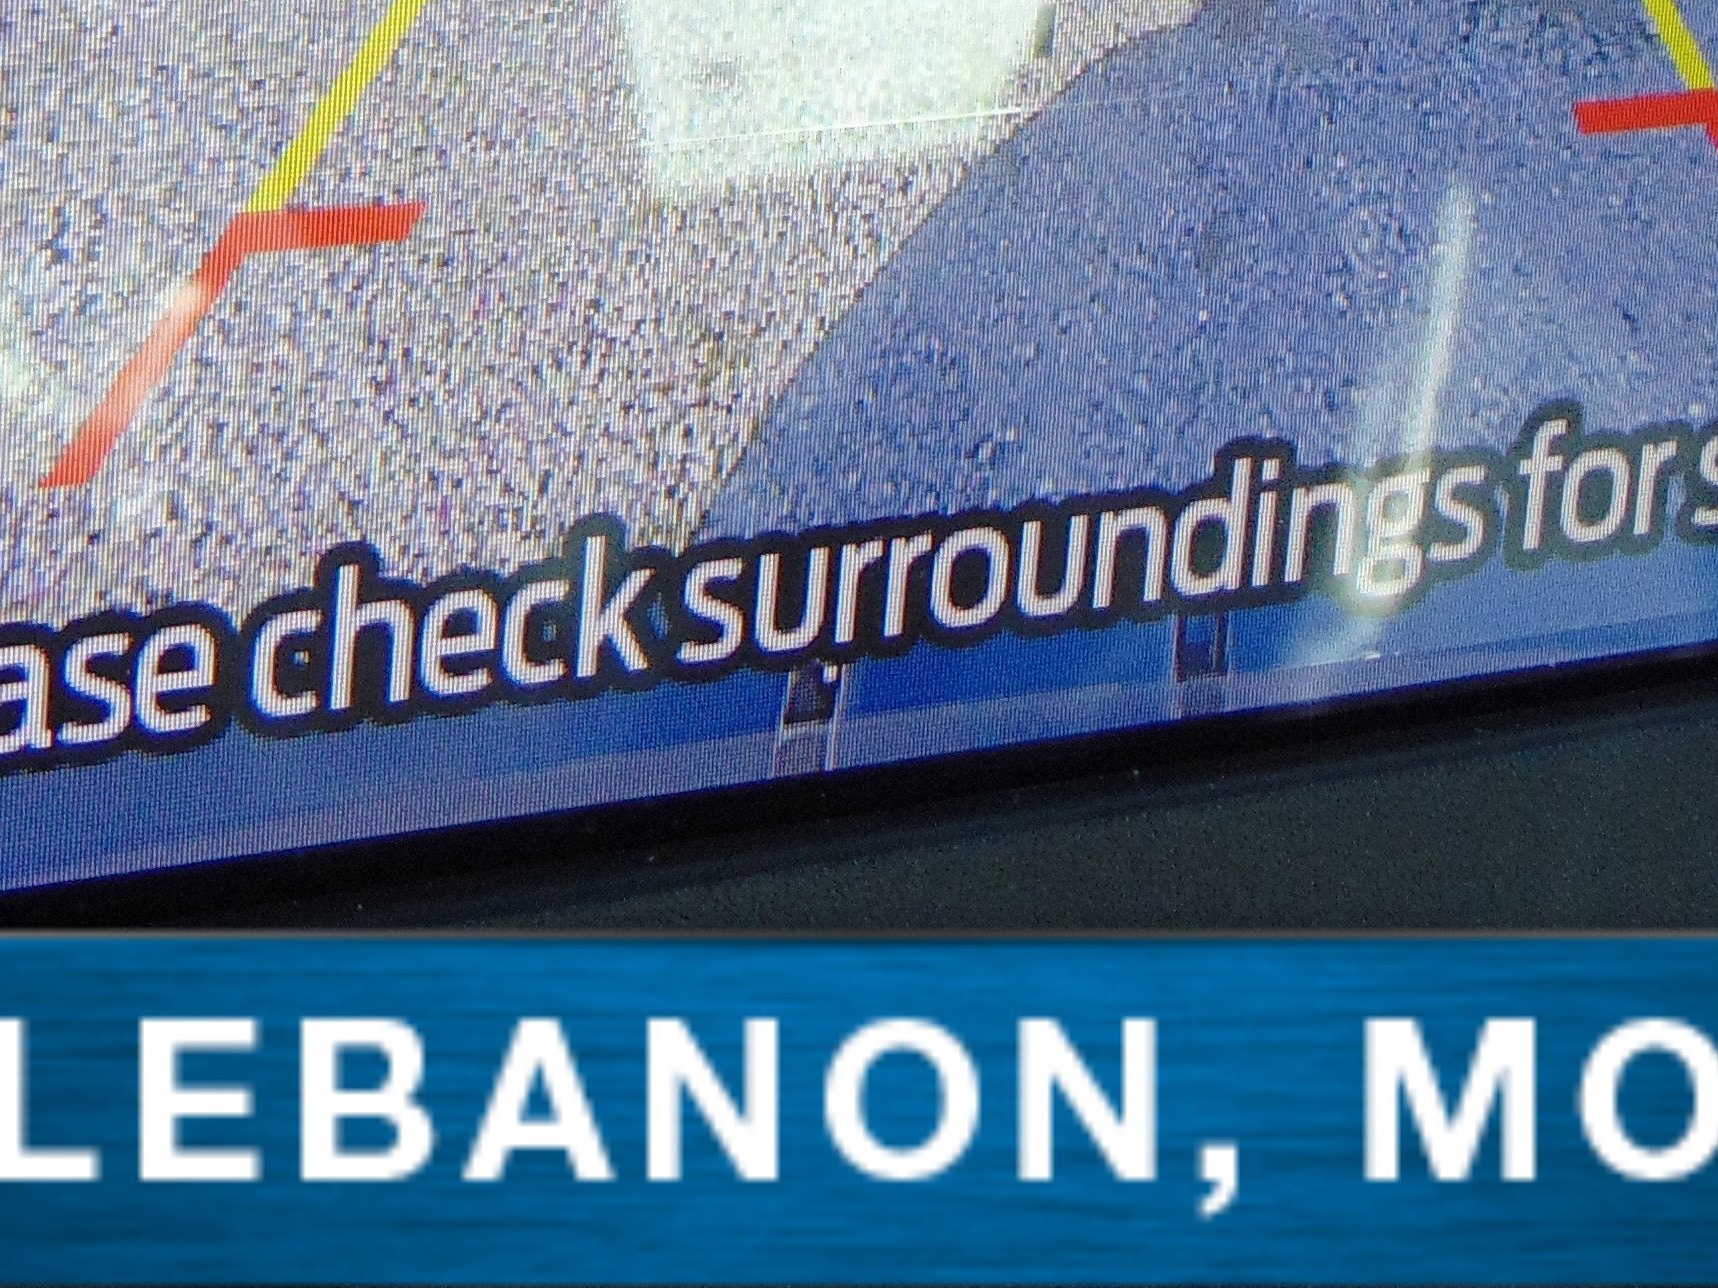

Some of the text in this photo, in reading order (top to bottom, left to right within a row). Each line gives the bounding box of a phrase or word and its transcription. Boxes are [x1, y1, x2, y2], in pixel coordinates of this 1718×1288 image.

[250, 534, 652, 717] check
[678, 454, 1487, 667] surroundings
[1517, 429, 1681, 551] for
